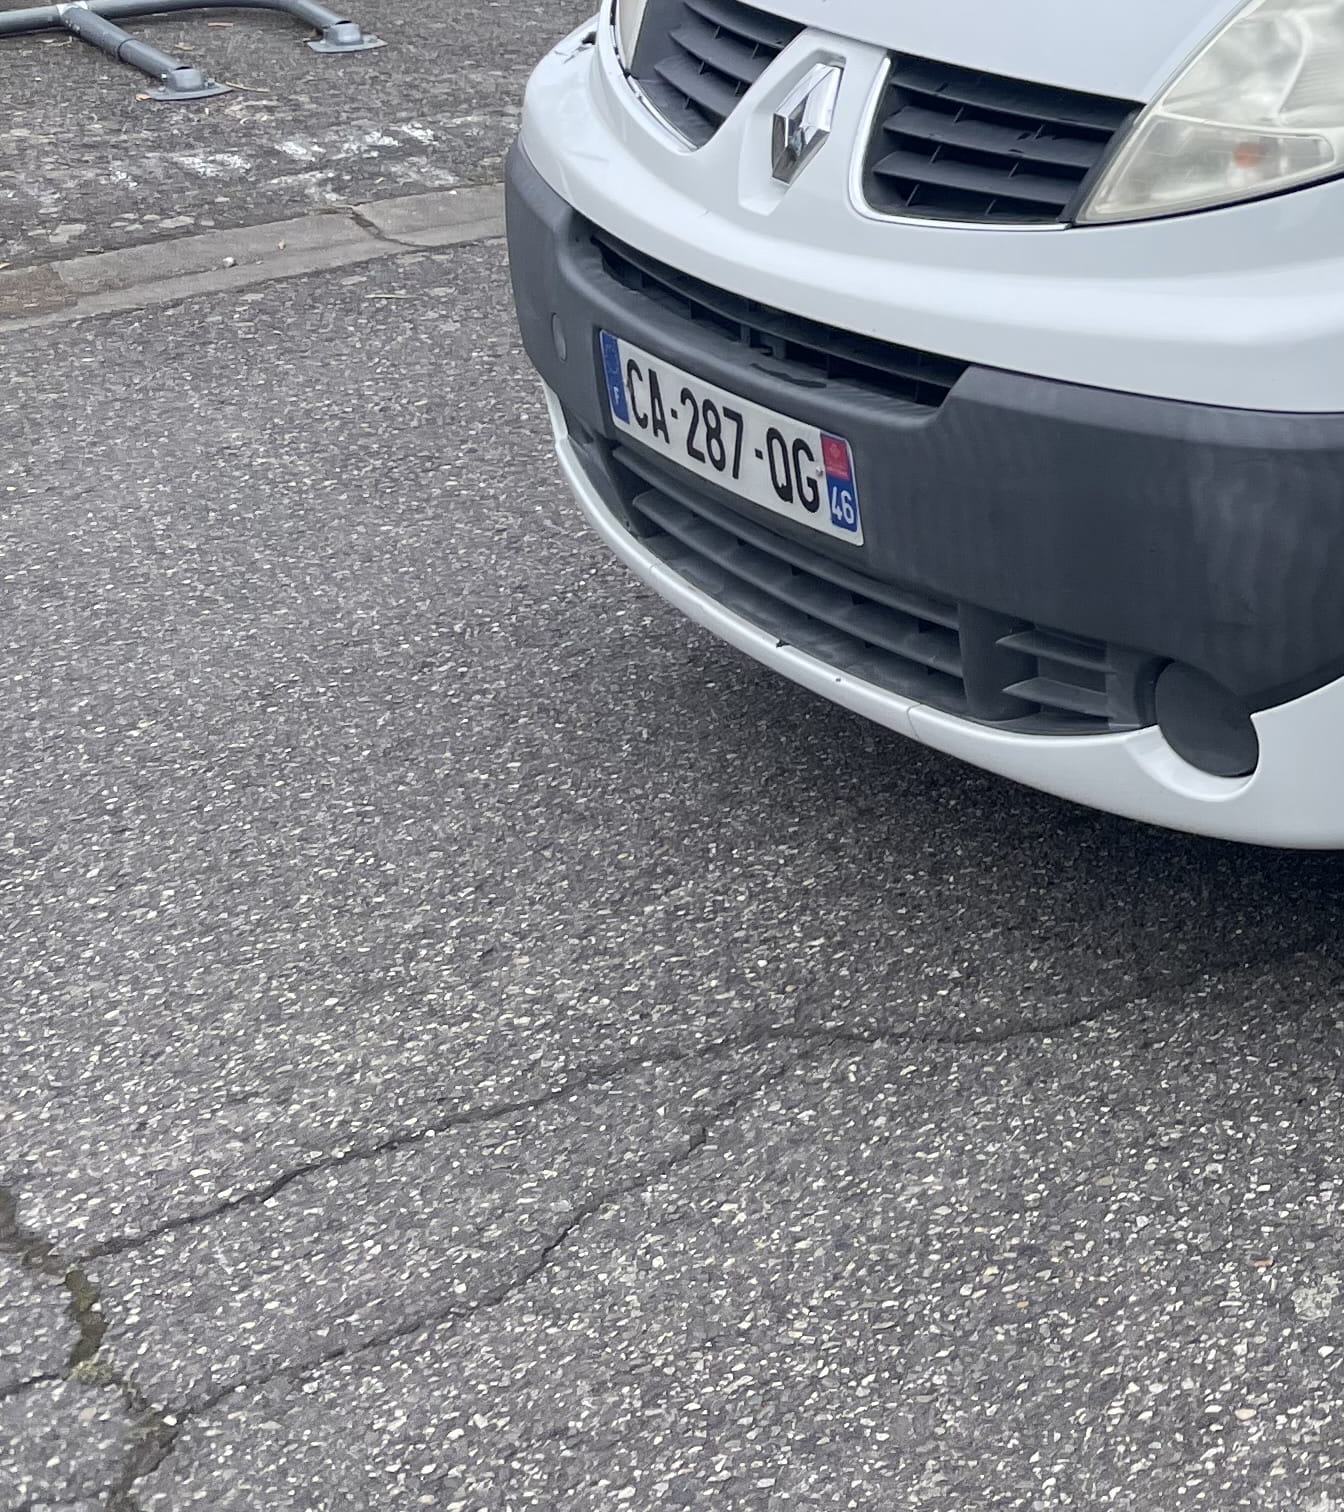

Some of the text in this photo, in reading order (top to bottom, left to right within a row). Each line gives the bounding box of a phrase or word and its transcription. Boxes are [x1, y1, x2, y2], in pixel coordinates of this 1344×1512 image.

[613, 358, 855, 525] F CA-287-QG 46
